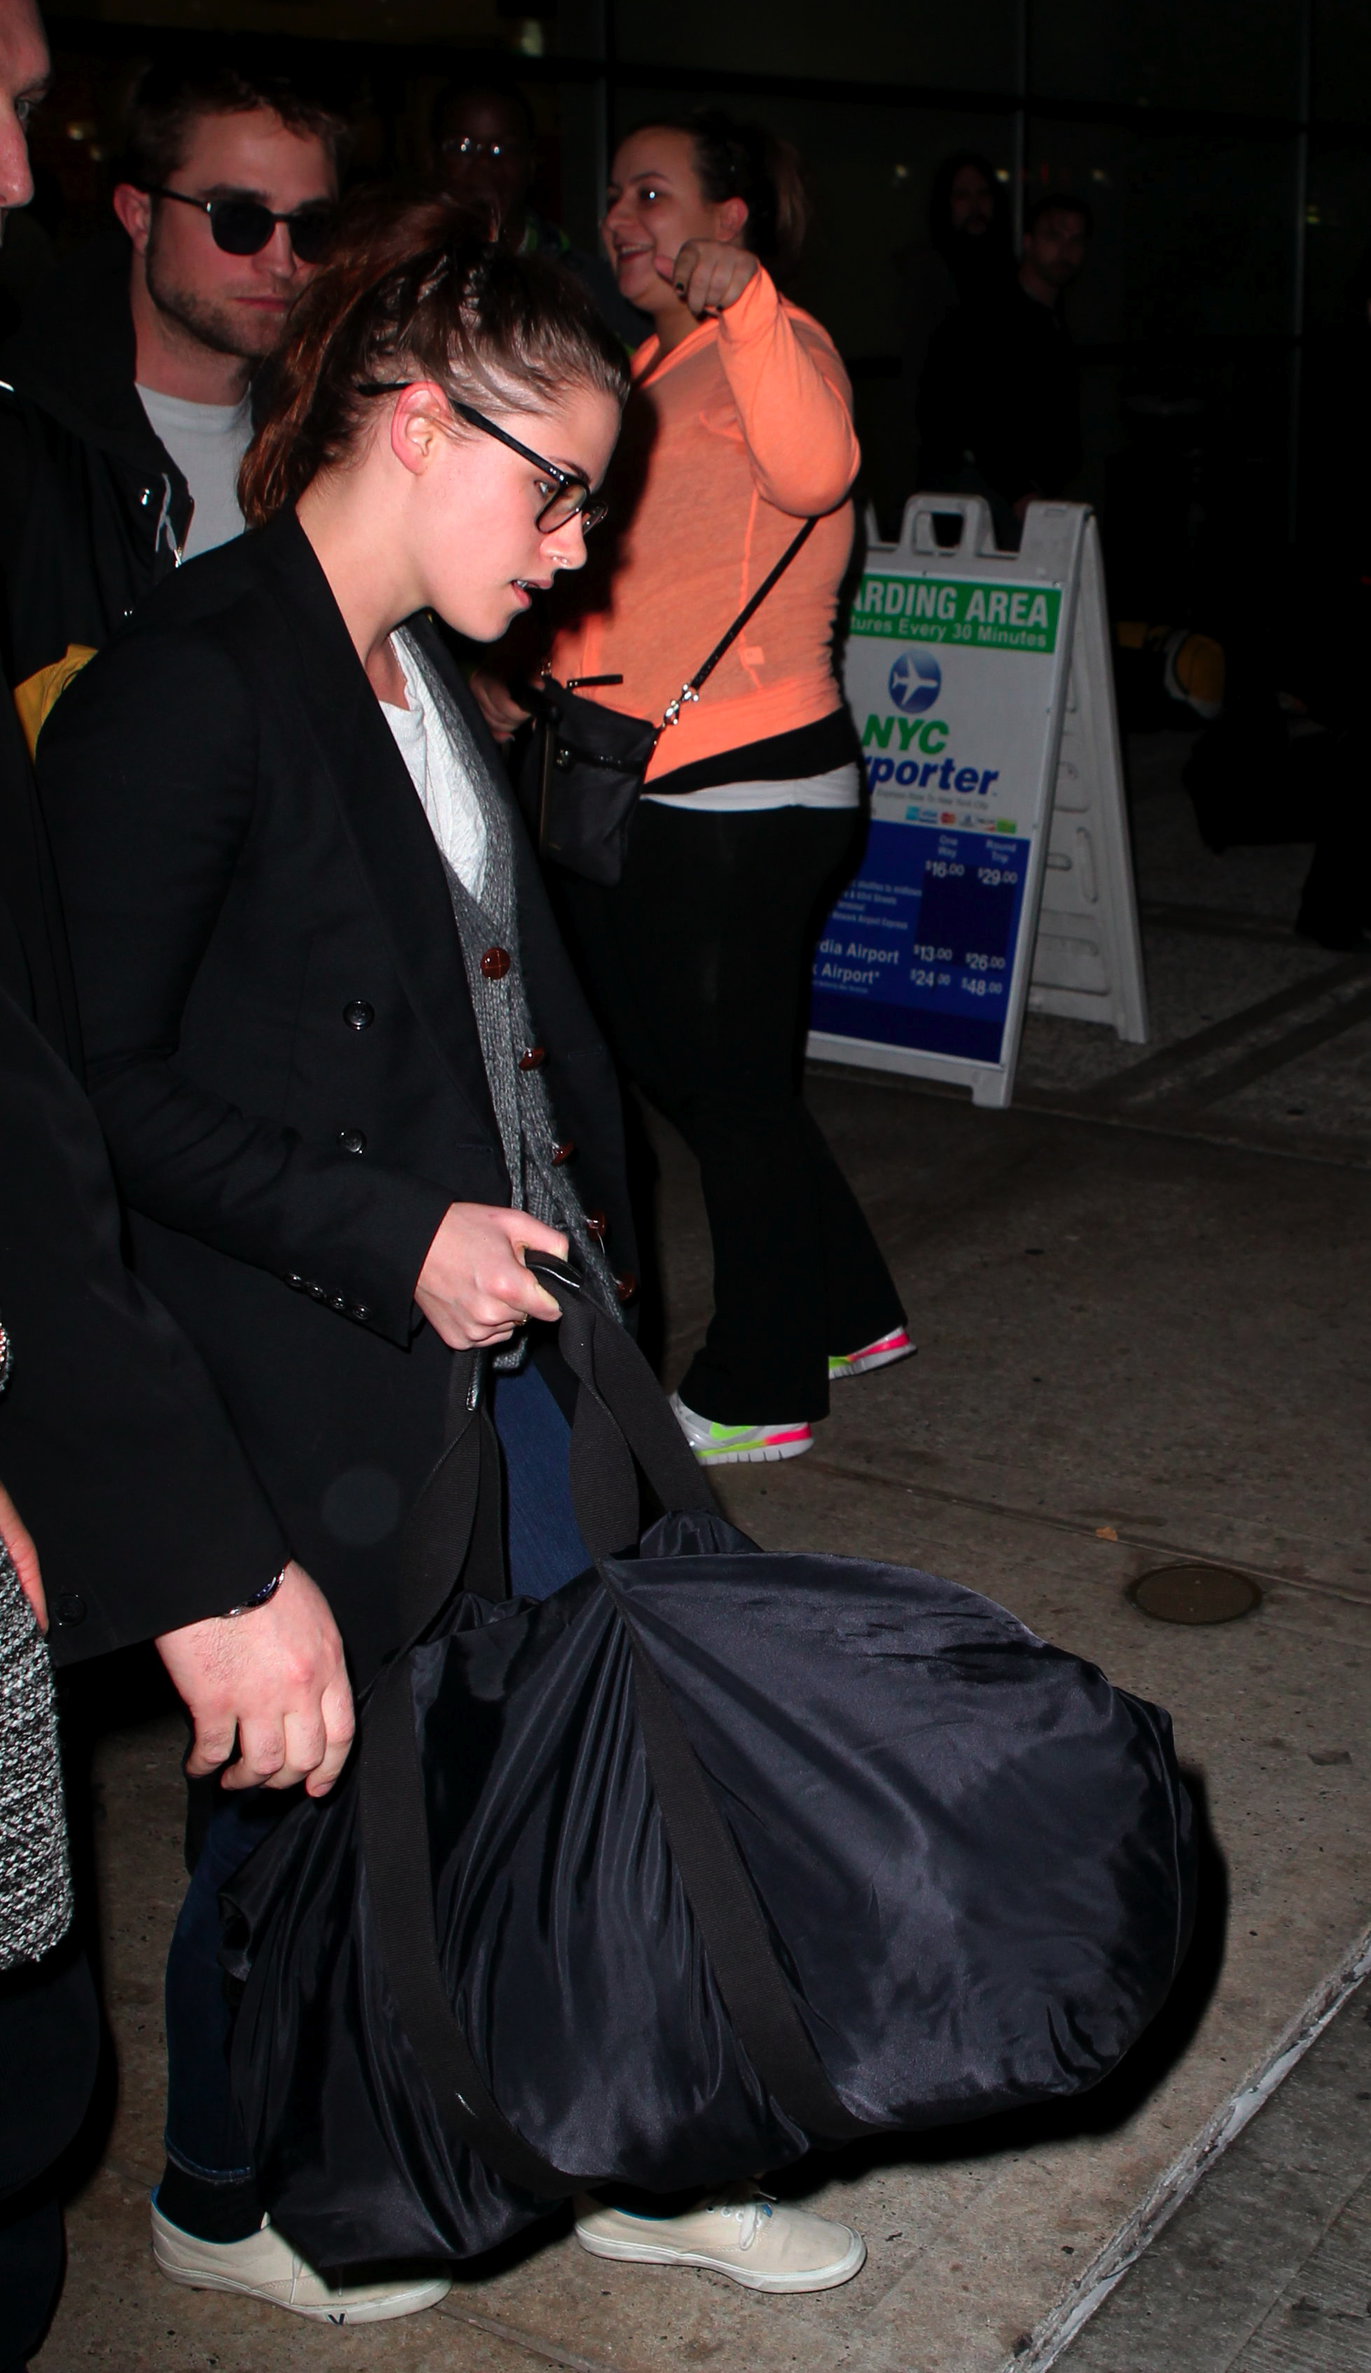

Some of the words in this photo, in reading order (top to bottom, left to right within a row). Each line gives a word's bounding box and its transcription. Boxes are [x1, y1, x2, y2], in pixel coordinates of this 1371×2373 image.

[964, 589, 1049, 629] AREA
[900, 617, 947, 642] Every
[951, 623, 972, 641] 30
[978, 625, 1047, 649] Minutes
[862, 714, 949, 754] NYC
[937, 846, 957, 859] Way
[939, 834, 959, 846] One
[986, 838, 1016, 853] Round
[991, 850, 1009, 864] Trip
[925, 860, 965, 878] $16.00
[977, 867, 1018, 886] $29.00
[846, 942, 899, 965] Airport
[913, 944, 953, 962] $13.00
[965, 952, 1006, 971] $26.00
[910, 968, 951, 987] $2400
[961, 976, 1003, 996] $48.00
